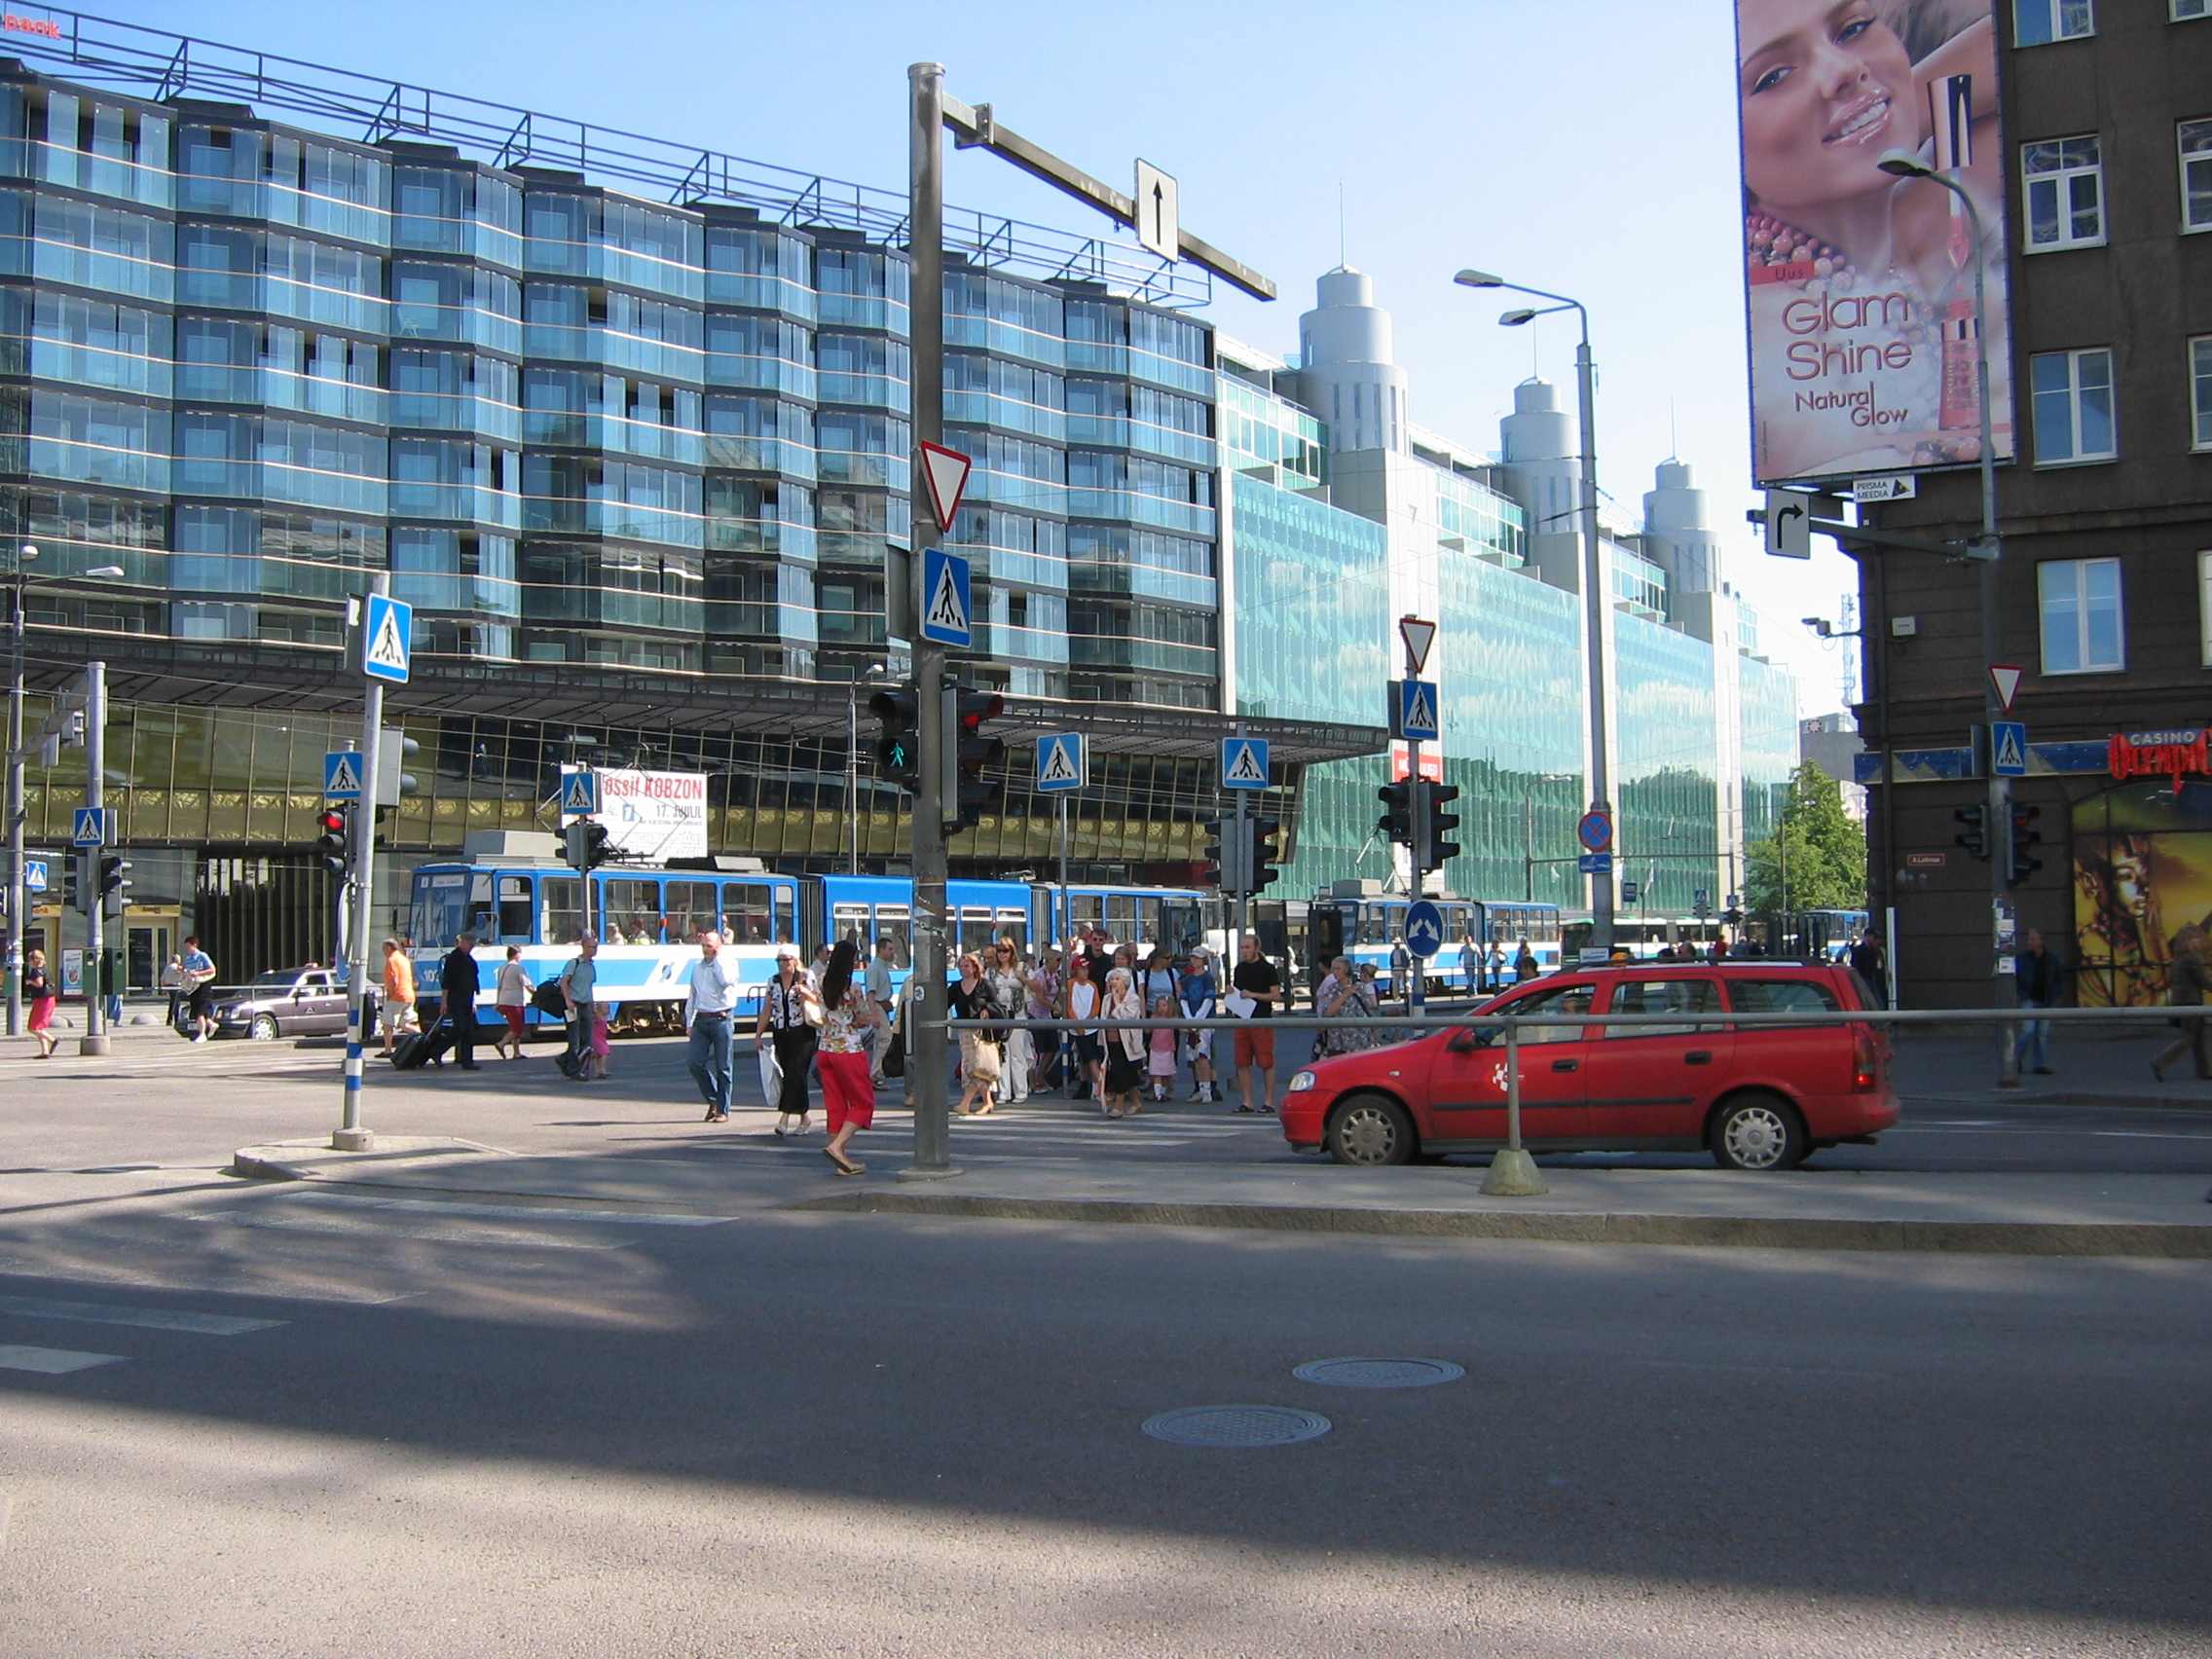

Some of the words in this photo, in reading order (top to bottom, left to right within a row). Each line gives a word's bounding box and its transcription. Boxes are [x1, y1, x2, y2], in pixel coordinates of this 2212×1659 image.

[1775, 267, 1803, 281] Uus
[1782, 290, 1909, 335] Glam
[1786, 339, 1912, 381] Shine
[1794, 381, 1875, 413] Natural
[1850, 403, 1908, 427] Glow
[2129, 731, 2196, 746] CASINO
[644, 778, 703, 800] KOBZON
